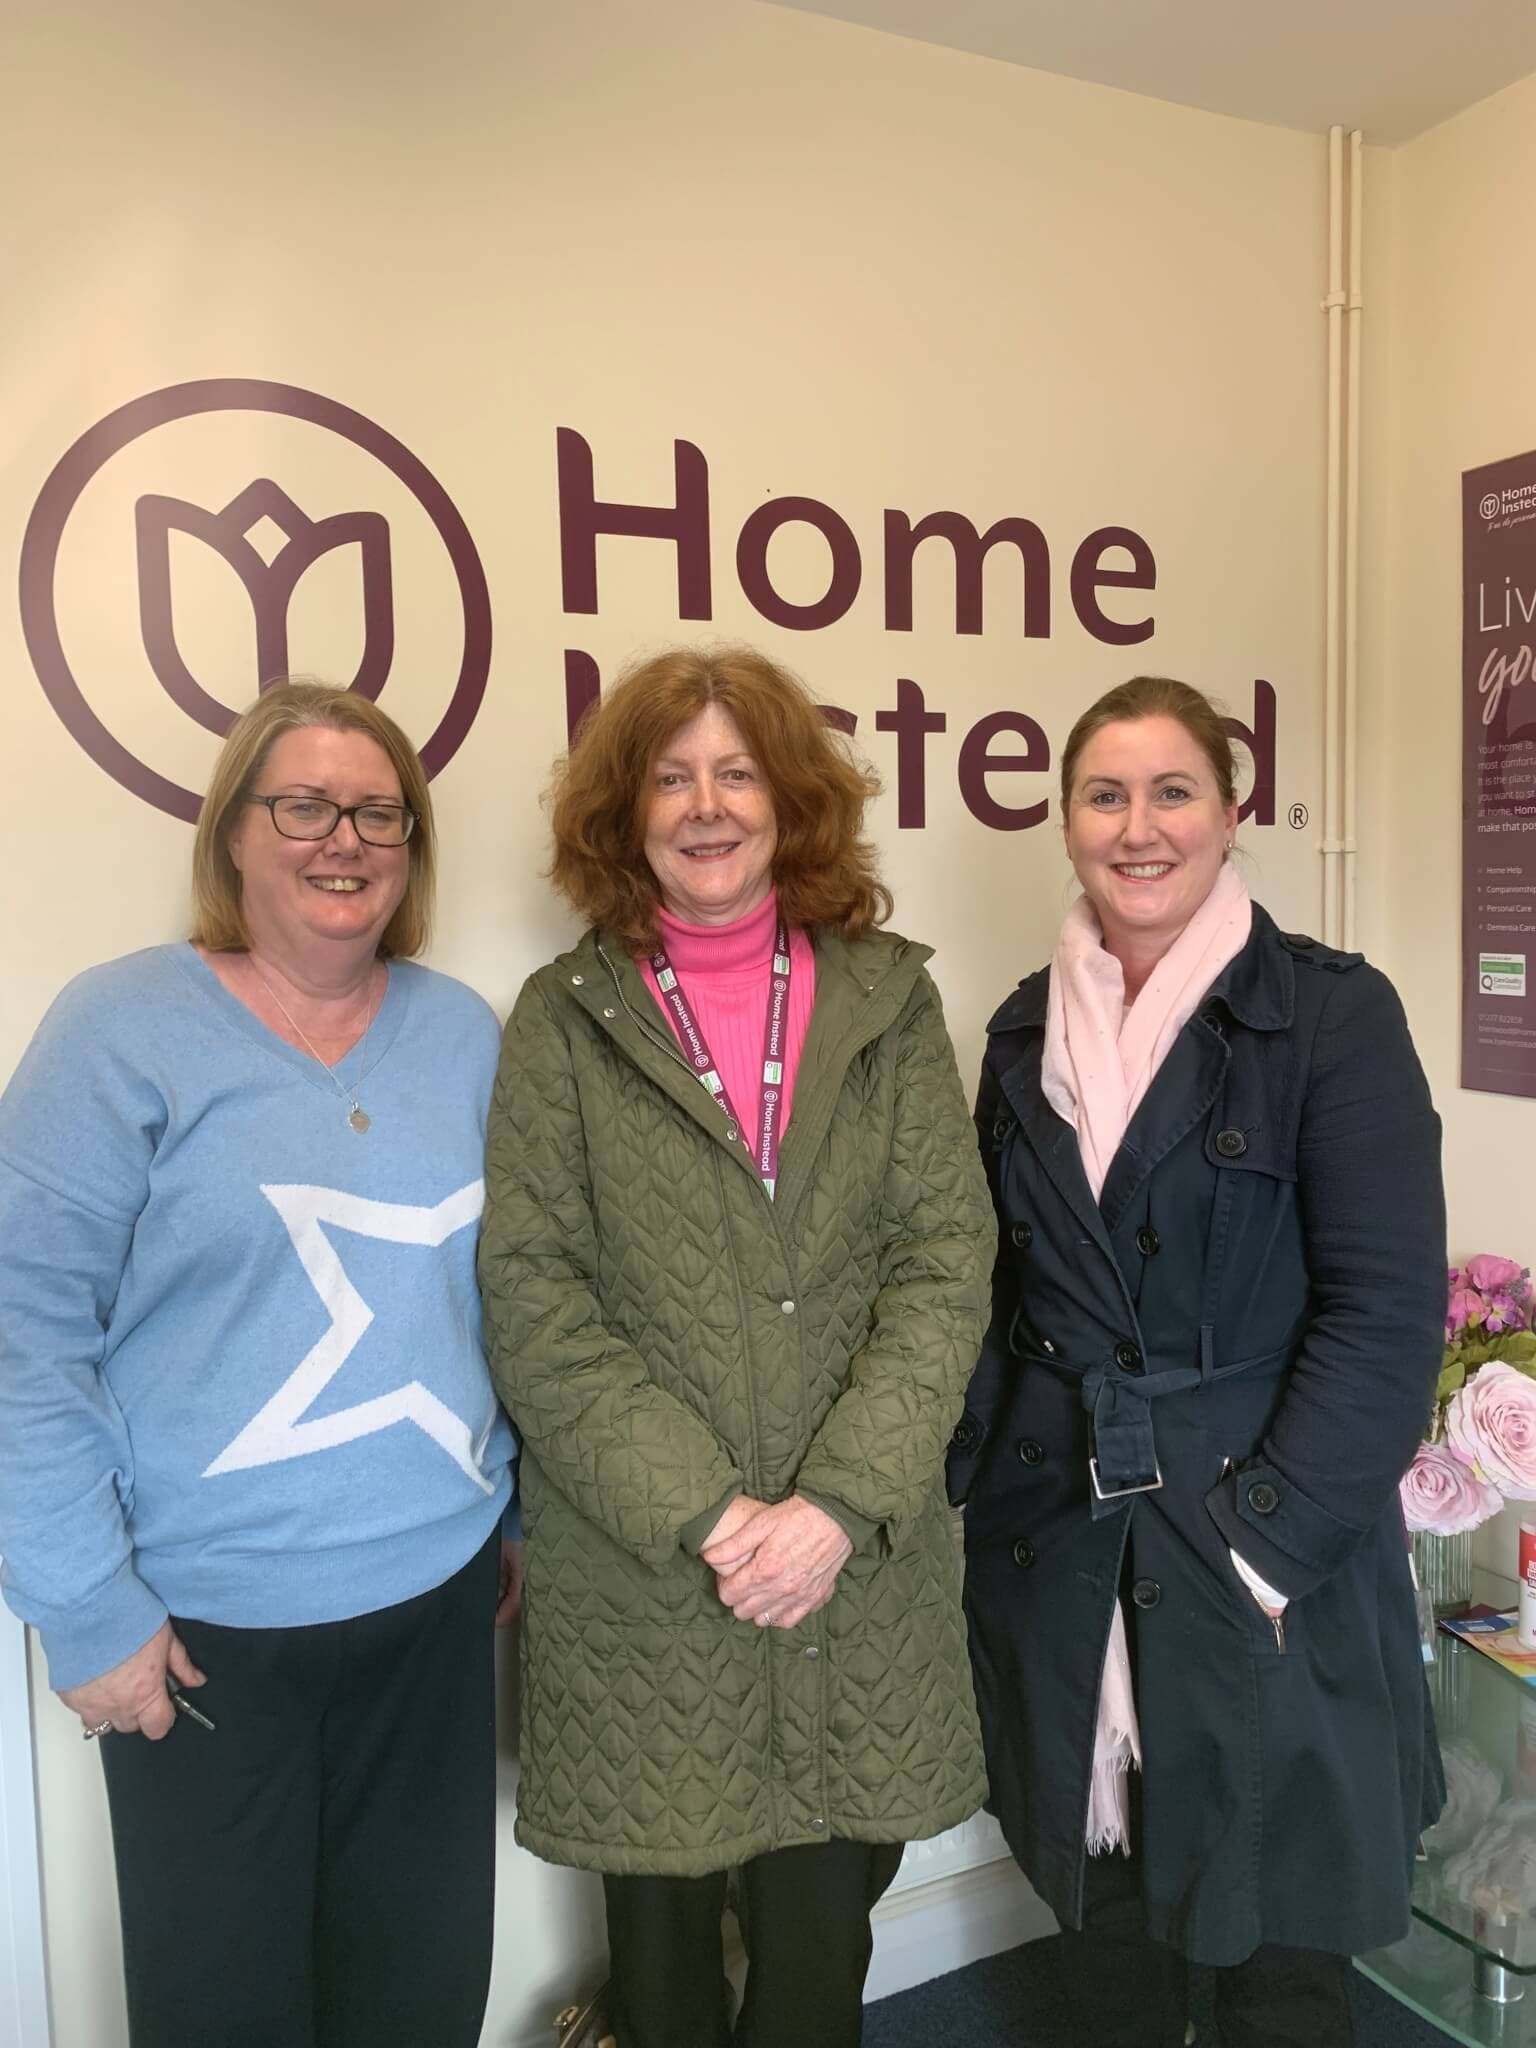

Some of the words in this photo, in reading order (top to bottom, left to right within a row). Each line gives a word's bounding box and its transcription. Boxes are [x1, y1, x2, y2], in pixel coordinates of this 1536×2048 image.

[557, 427, 1157, 645] Home
[1498, 742, 1523, 752] home
[1478, 760, 1498, 770] most
[1495, 791, 1514, 801] want
[1478, 823, 1500, 833] make
[1502, 822, 1520, 832] that
[1516, 904, 1532, 913] Care
[670, 993, 691, 1029] Instead
[773, 992, 784, 1020] Home
[686, 1027, 703, 1056] Home
[770, 1021, 781, 1056] Instead
[764, 1103, 775, 1131] Home
[761, 1132, 773, 1172] Instead
